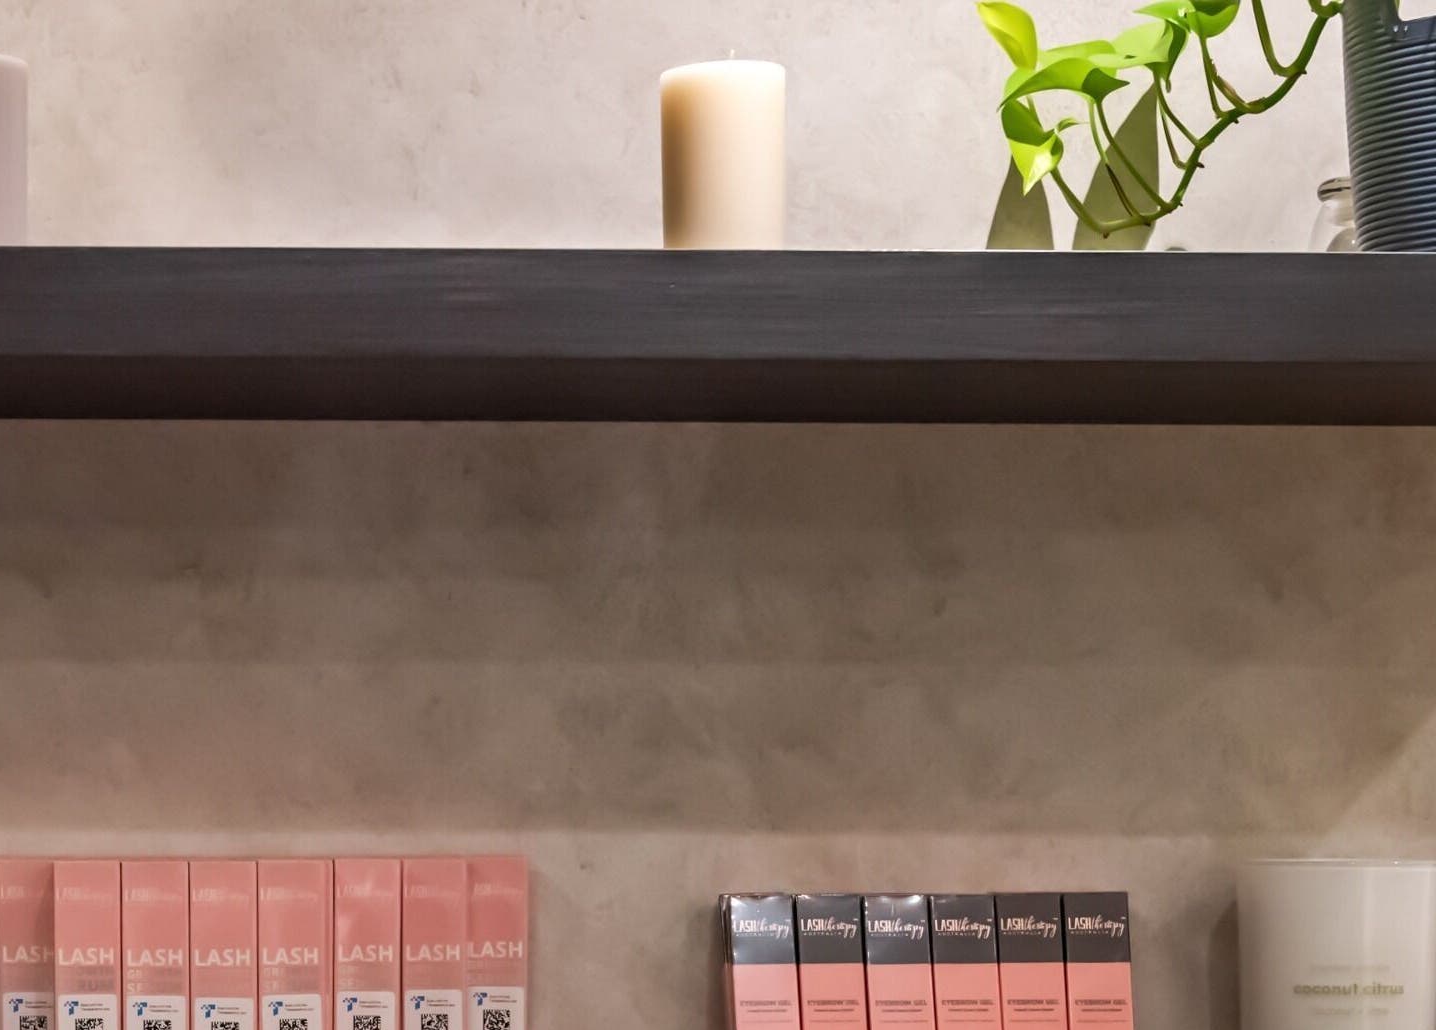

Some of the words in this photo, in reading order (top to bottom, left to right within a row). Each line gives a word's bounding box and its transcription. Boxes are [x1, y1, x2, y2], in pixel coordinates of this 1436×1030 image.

[2, 947, 54, 964] LASH
[58, 948, 114, 965] LASH
[127, 949, 183, 966] LASH
[195, 949, 250, 966] LASH
[263, 947, 319, 965] LASH
[338, 945, 393, 962] LASH
[406, 944, 460, 961] LASH
[469, 941, 523, 958] LASH
[1293, 984, 1358, 995] coconut
[1363, 982, 1404, 995] citrus
